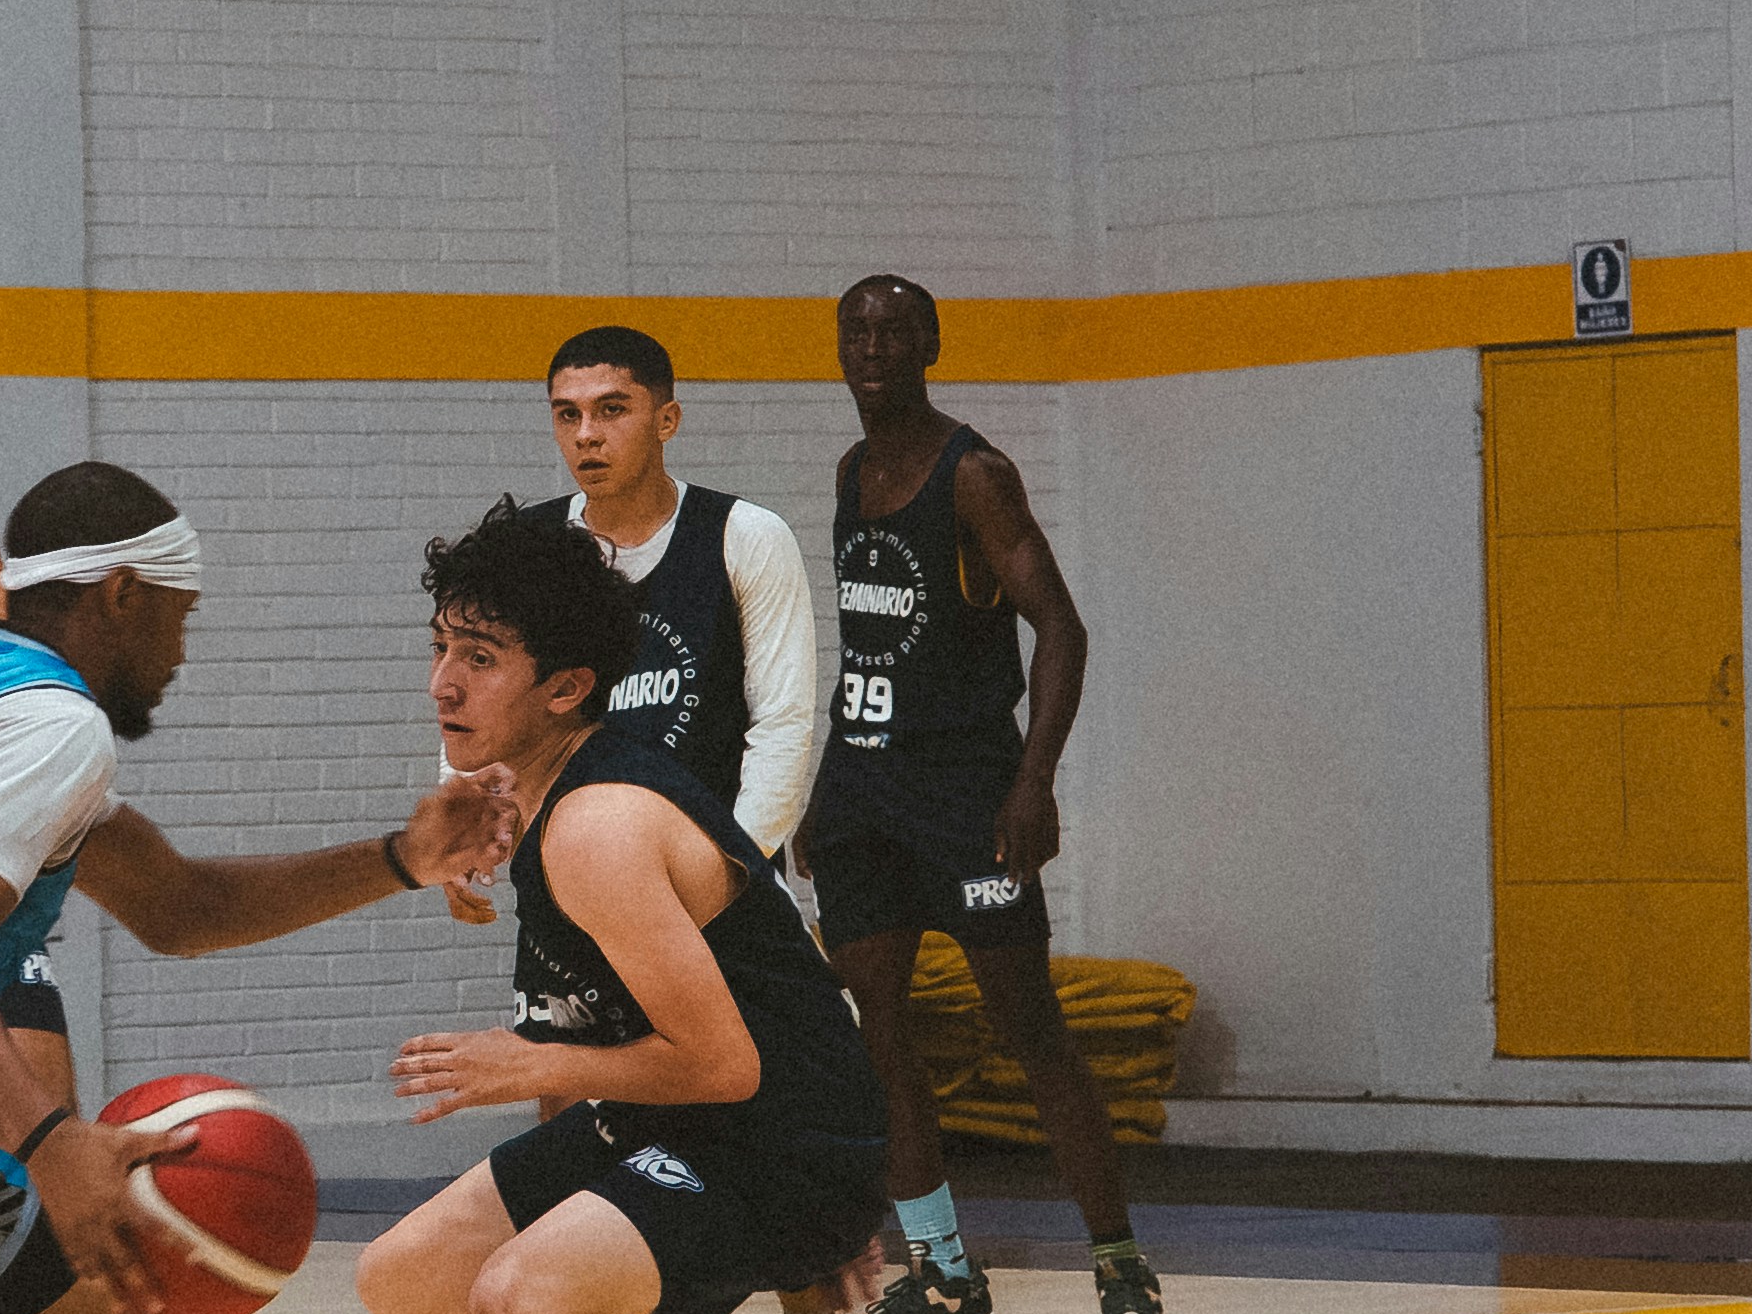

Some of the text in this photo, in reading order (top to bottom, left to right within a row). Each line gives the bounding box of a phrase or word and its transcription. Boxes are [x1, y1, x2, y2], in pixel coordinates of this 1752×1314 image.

[838, 580, 914, 617] EMINARIO
[900, 612, 928, 654] Gold
[607, 667, 680, 712] NARIO
[663, 694, 699, 748] Gold
